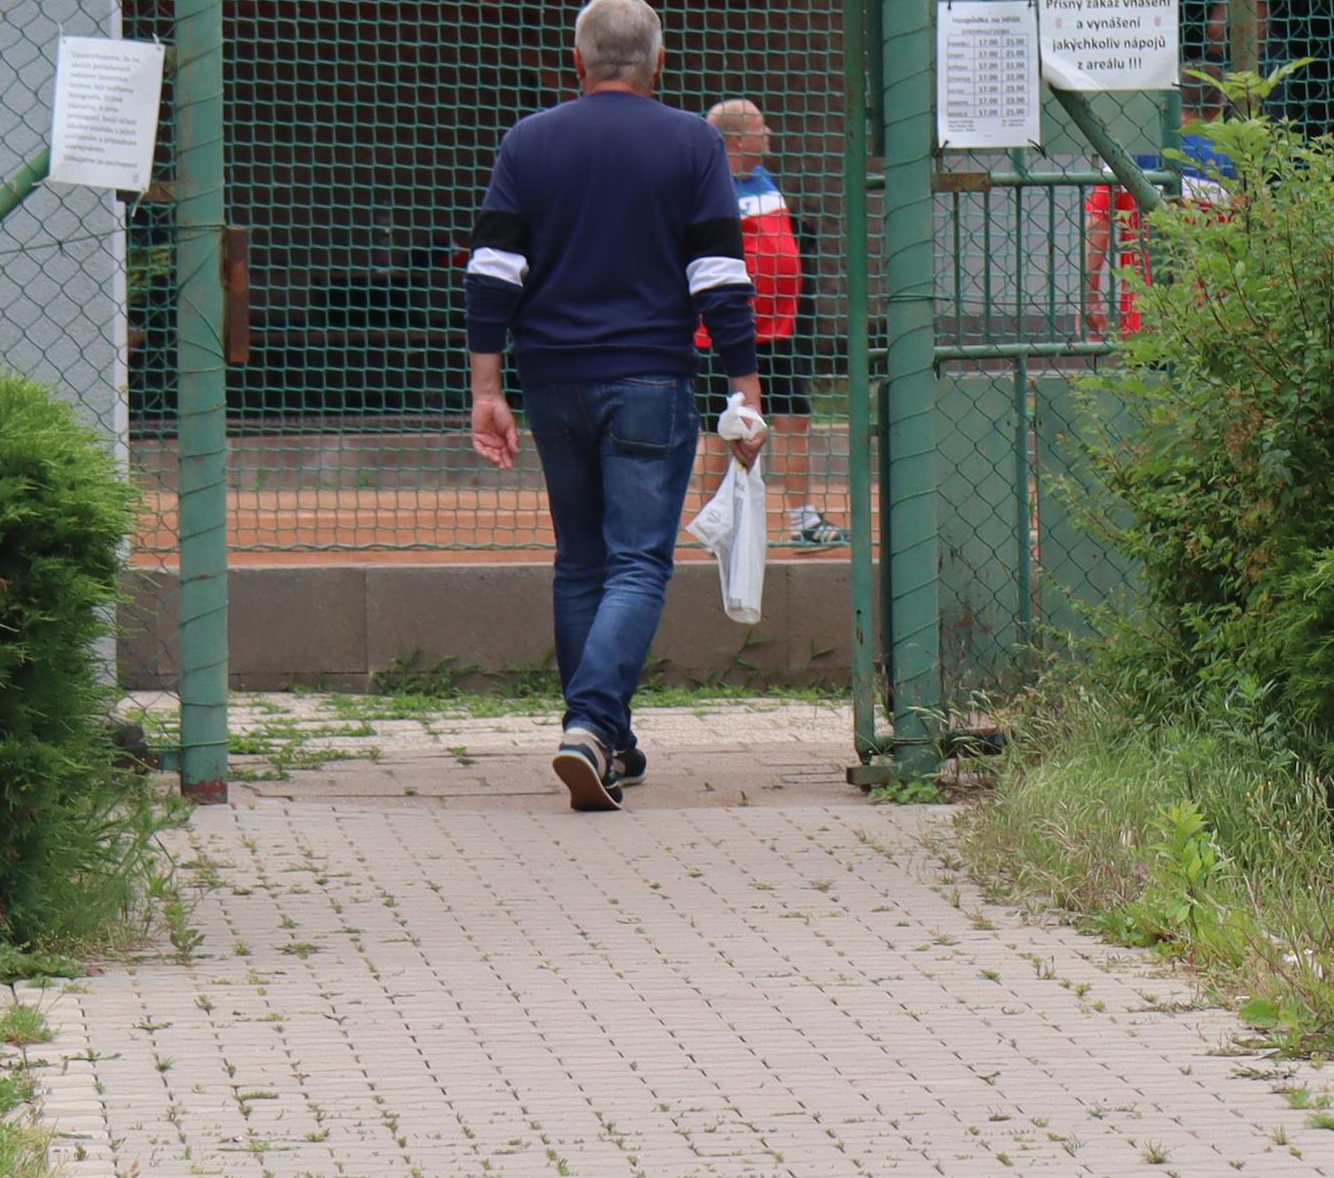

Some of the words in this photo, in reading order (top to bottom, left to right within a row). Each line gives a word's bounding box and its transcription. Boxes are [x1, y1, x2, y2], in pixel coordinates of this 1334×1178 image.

[1076, 20, 1083, 29] a
[1087, 16, 1141, 31] vynášení
[1052, 37, 1120, 53] jakýchkoliv
[1124, 35, 1166, 51] nápojů
[1077, 61, 1084, 70] z
[1087, 57, 1125, 70] areálu
